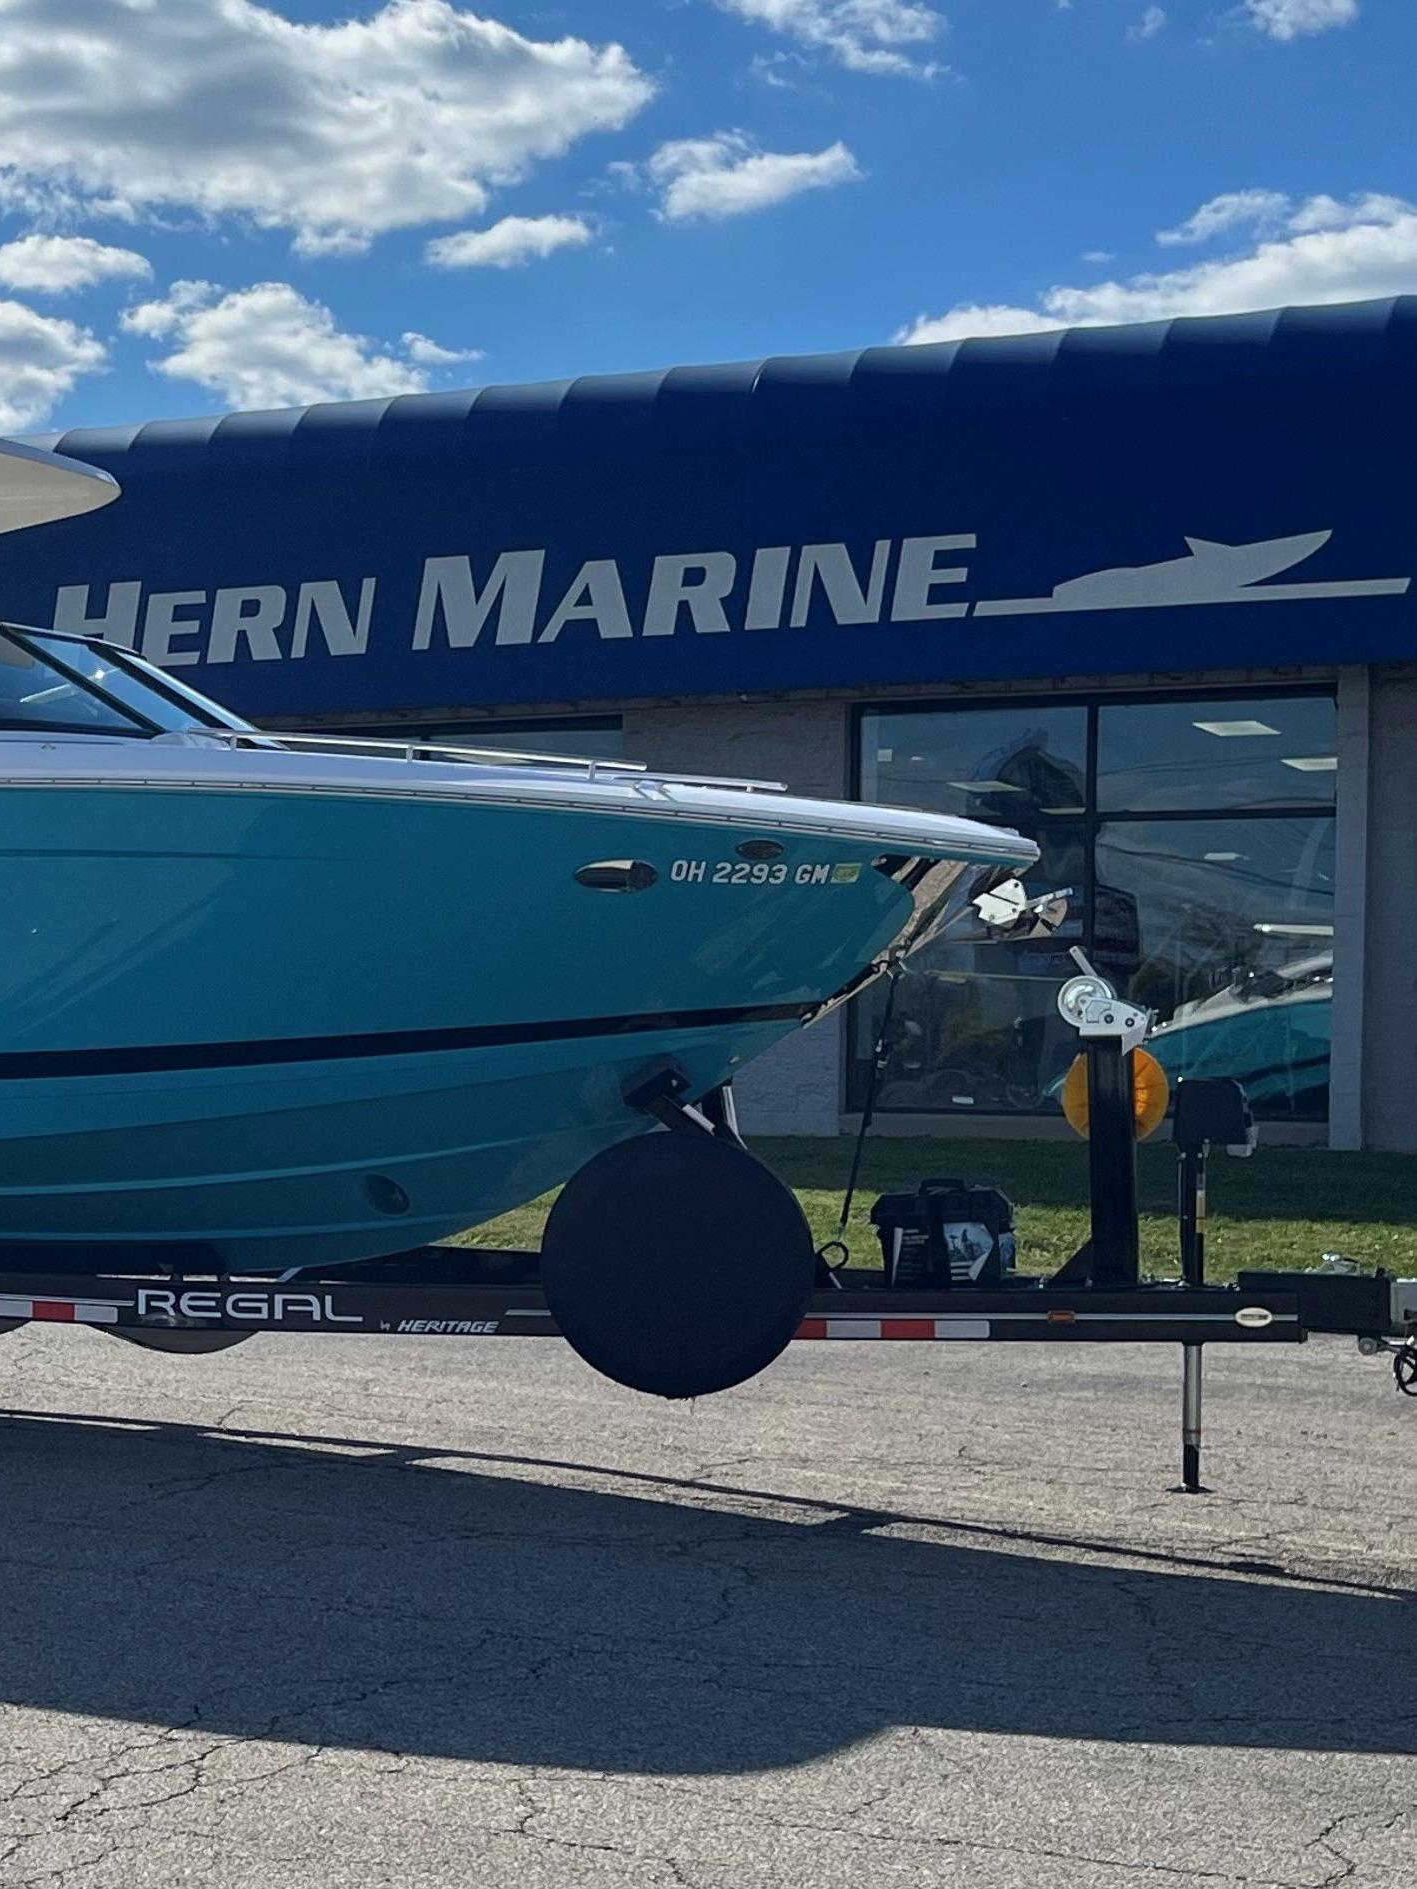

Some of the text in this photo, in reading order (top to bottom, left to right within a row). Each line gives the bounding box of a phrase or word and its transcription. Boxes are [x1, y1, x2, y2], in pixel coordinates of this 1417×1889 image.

[53, 533, 977, 667] HERN MARINE
[670, 859, 707, 883] OH
[712, 862, 788, 885] 2293
[794, 863, 831, 885] GM
[138, 1289, 364, 1323] REGAL
[397, 1319, 500, 1334] HERITAGE
